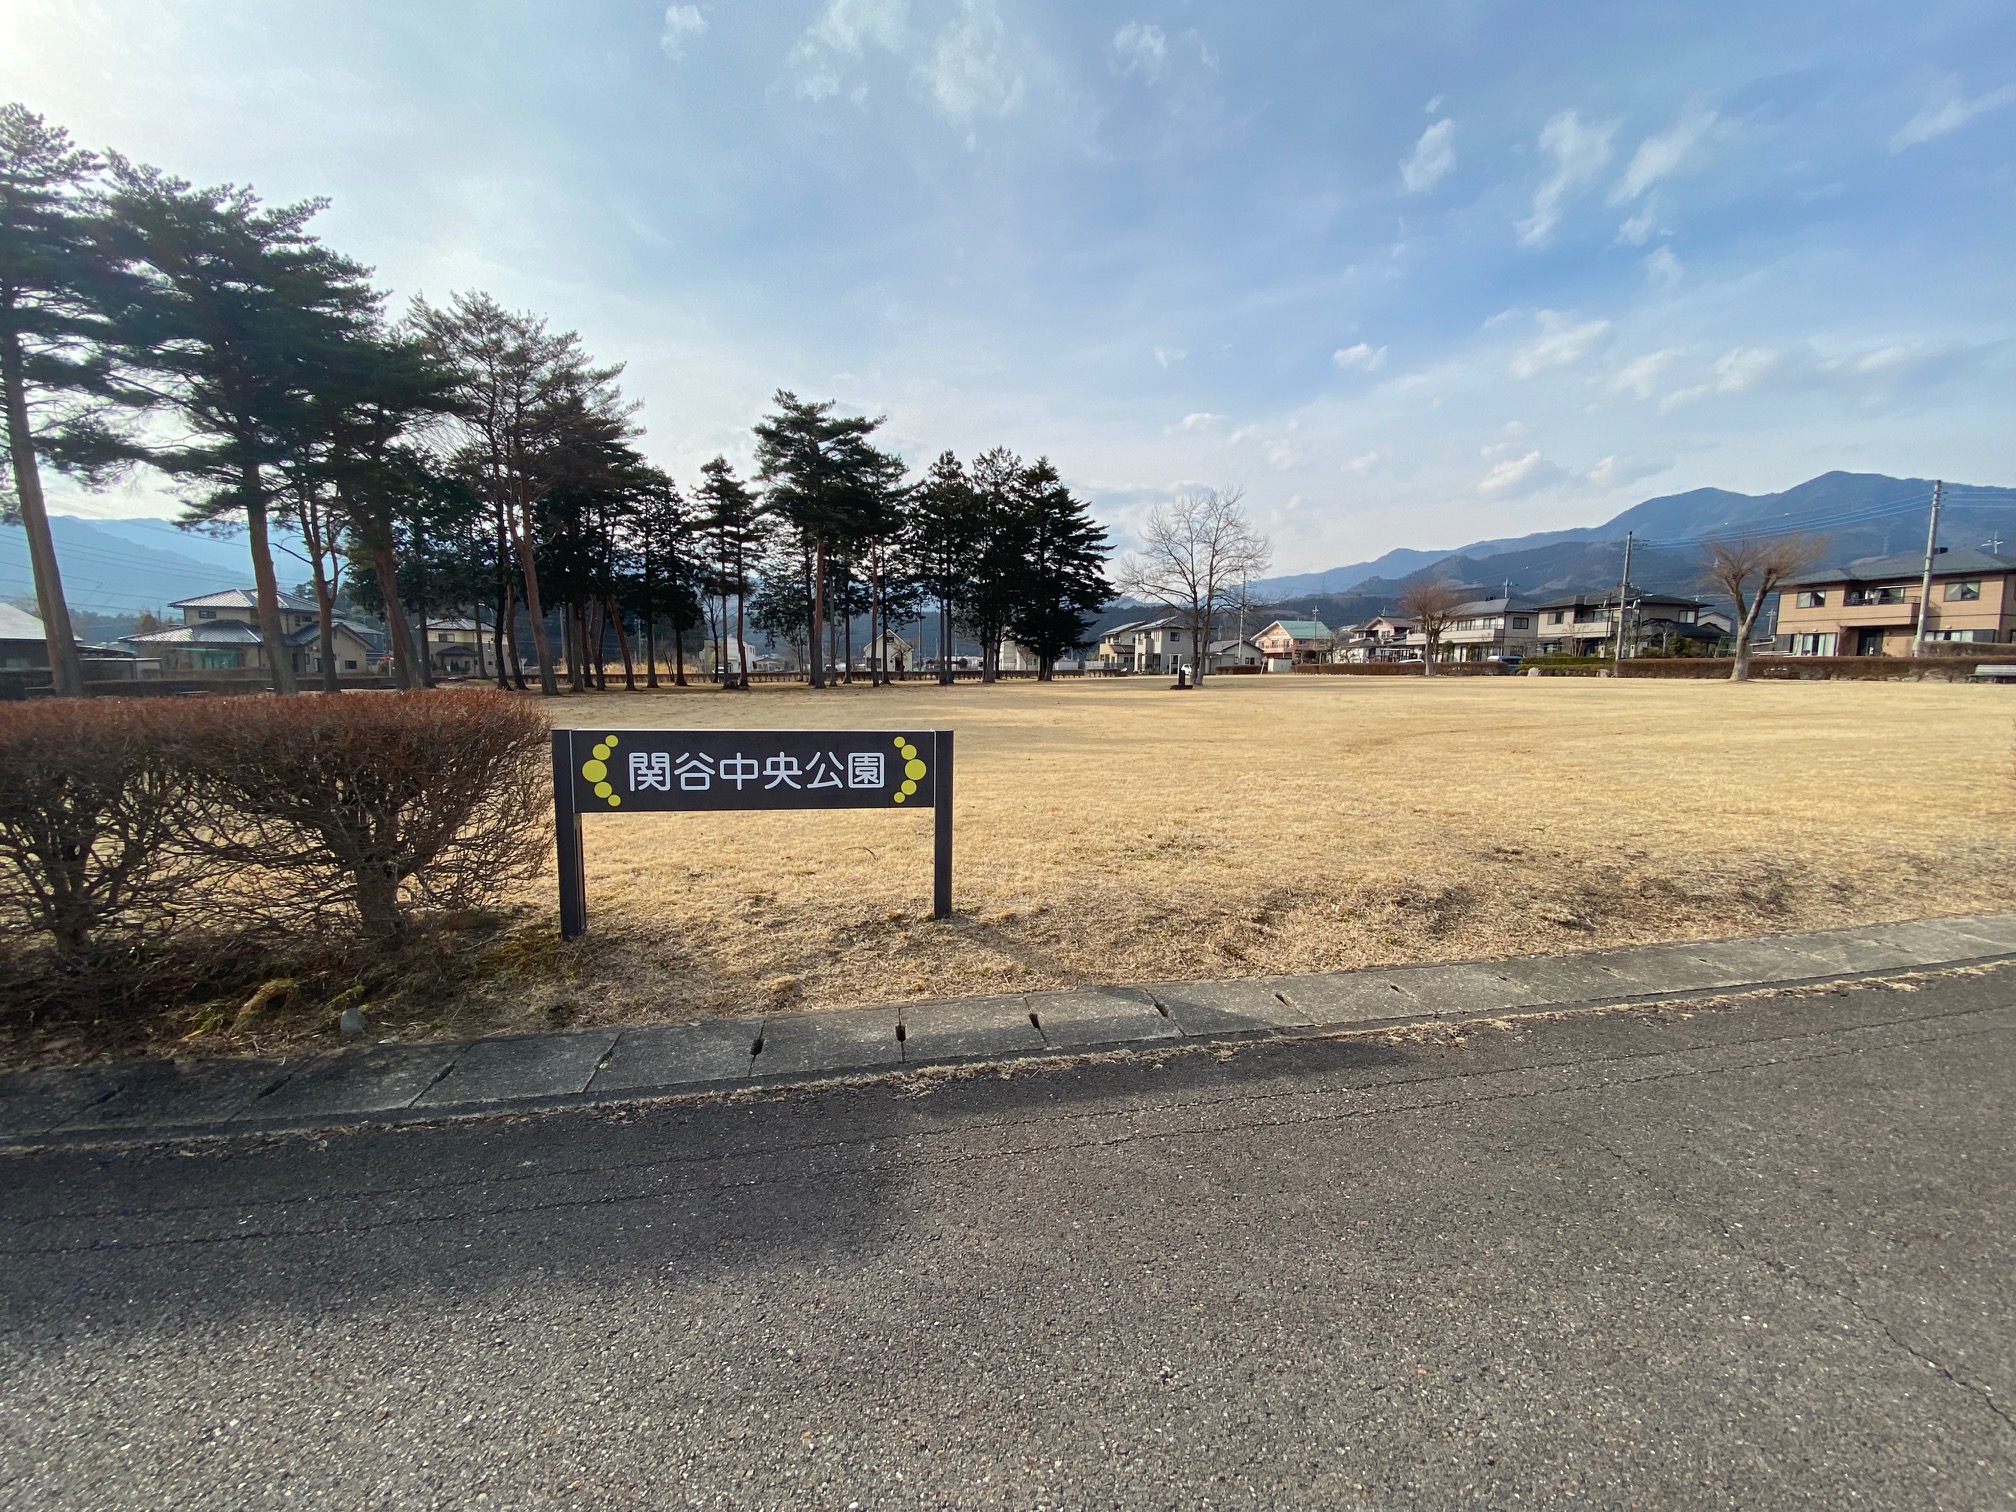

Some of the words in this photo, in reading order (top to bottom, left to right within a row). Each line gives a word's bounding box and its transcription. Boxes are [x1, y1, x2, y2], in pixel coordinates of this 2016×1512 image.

[628, 751, 884, 791] 関谷中央公園
